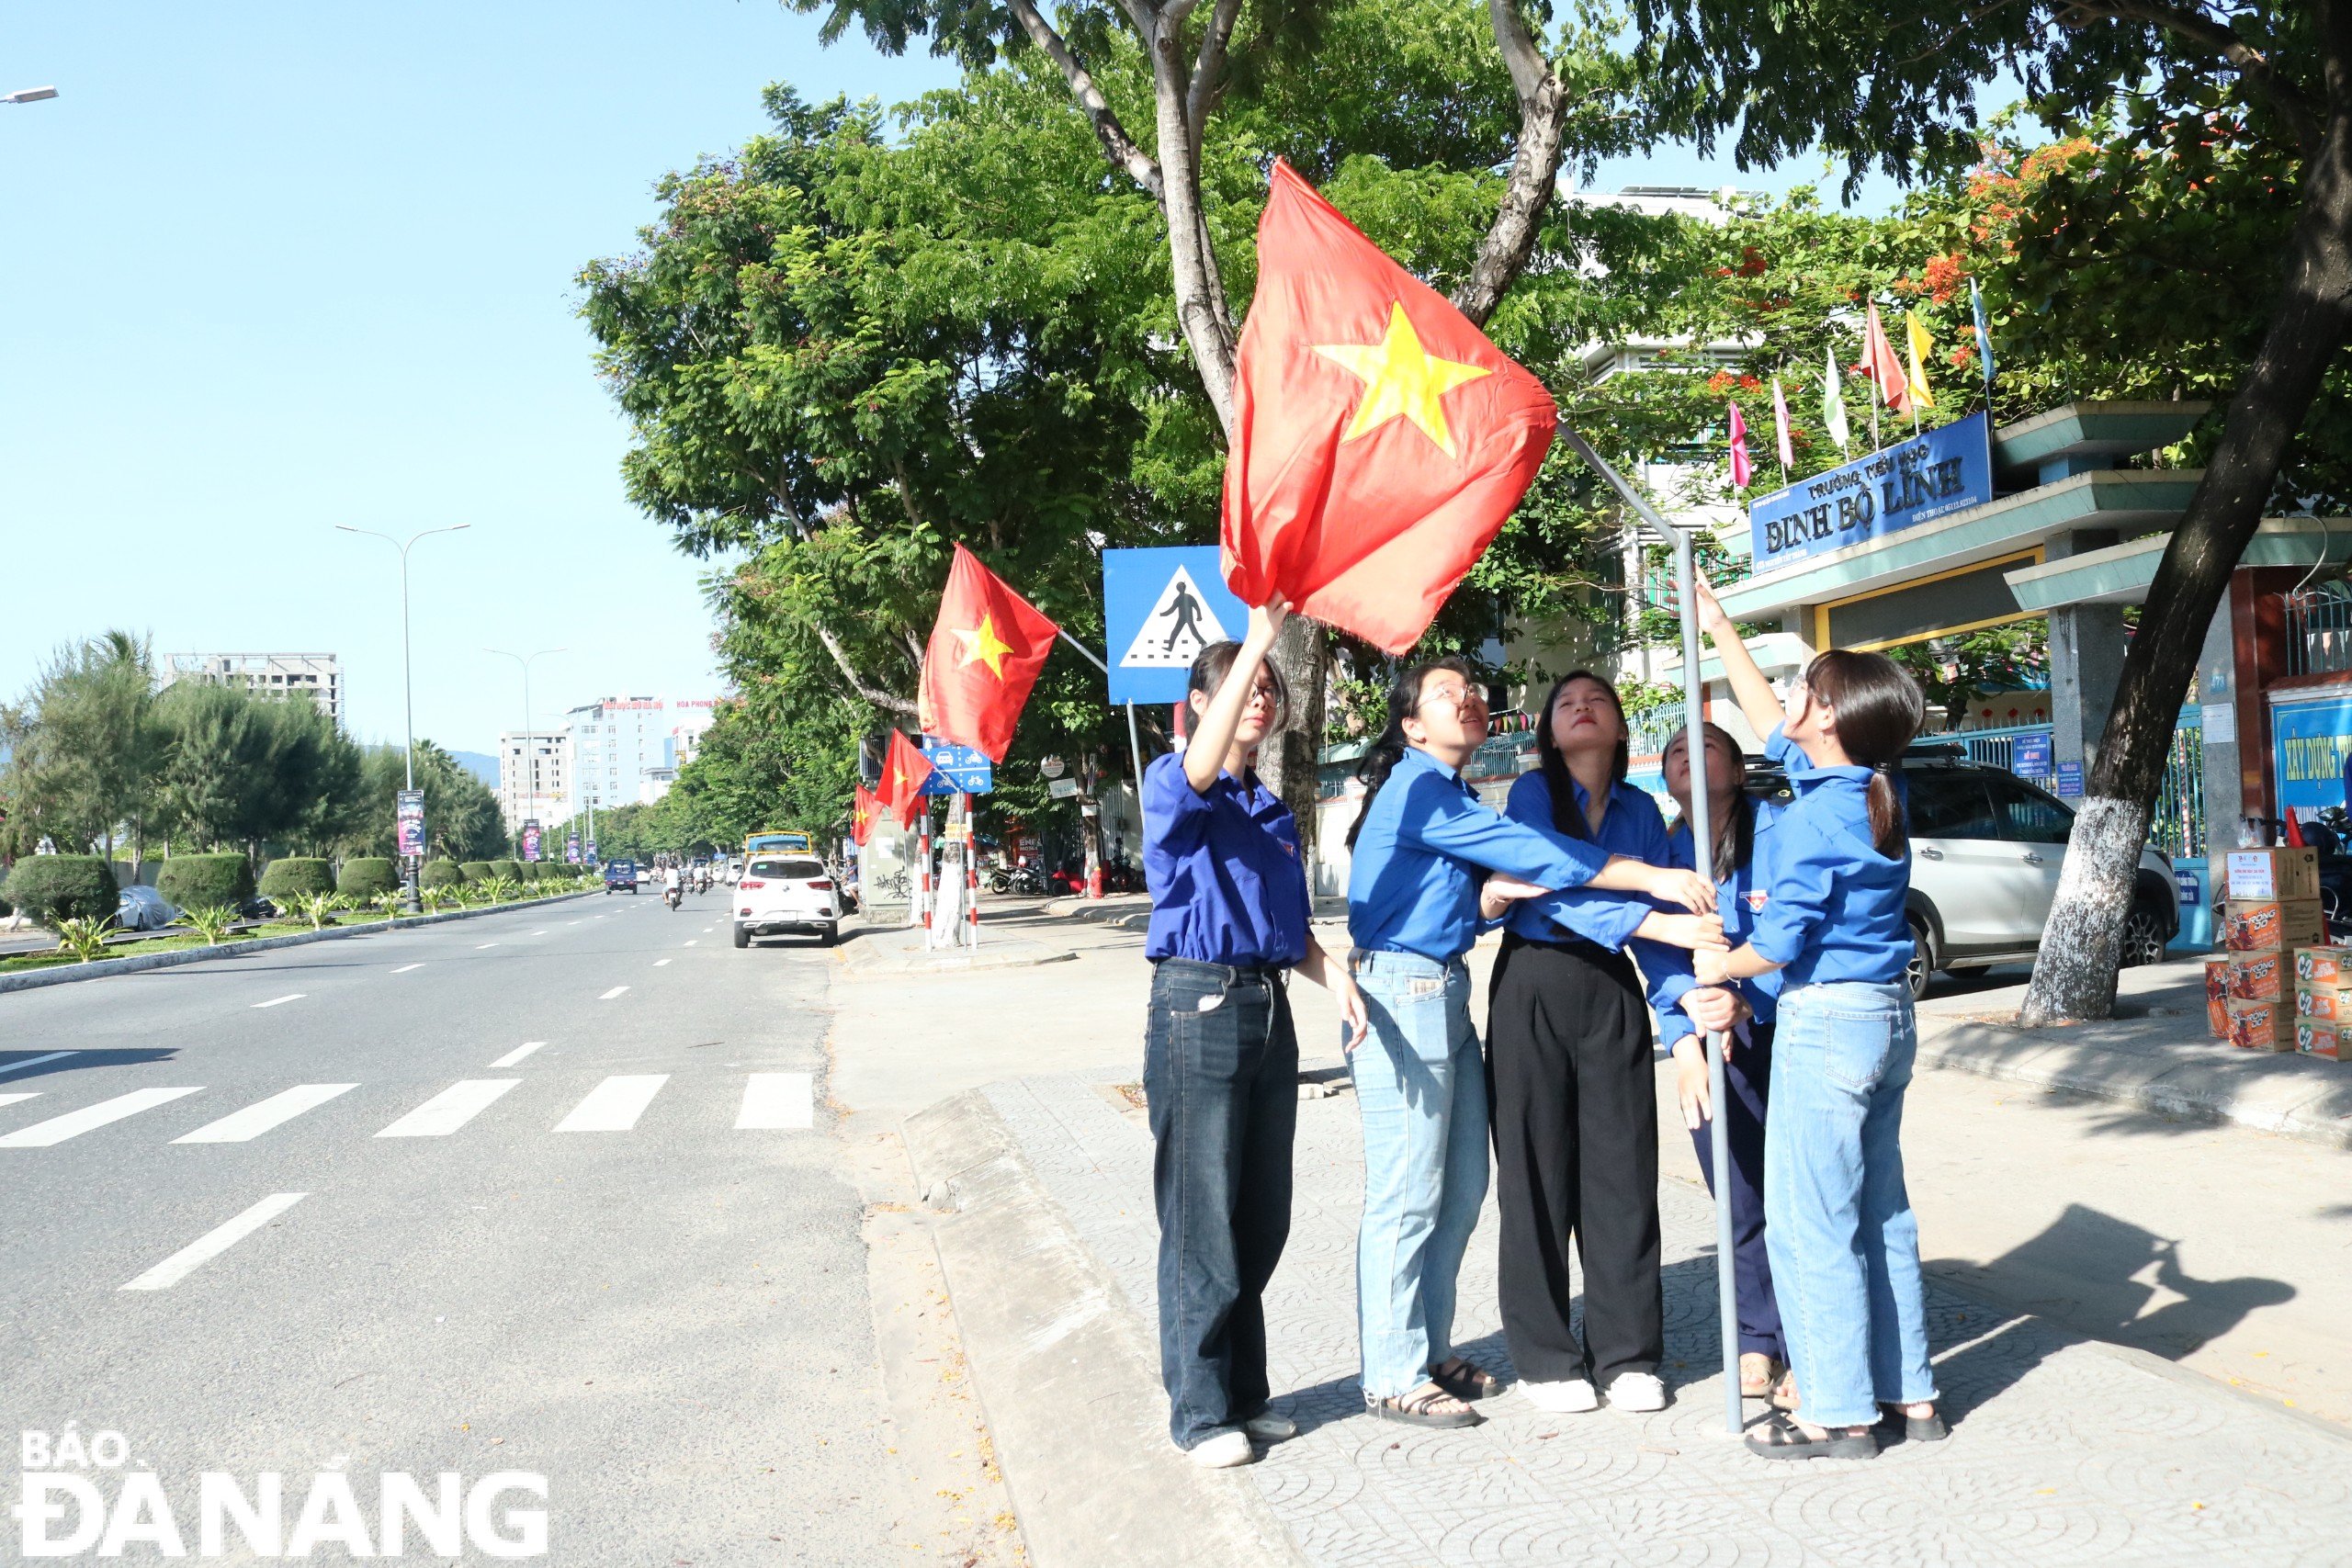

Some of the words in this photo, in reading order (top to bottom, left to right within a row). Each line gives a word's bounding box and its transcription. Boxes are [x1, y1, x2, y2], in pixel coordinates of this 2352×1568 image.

[1765, 502, 1834, 554] ĐINH
[1836, 482, 1877, 530] BỘ
[2284, 727, 2305, 781] XÂY
[2306, 732, 2336, 790] DỰNG
[2298, 954, 2312, 980] C2
[2299, 990, 2312, 1016] C2
[2339, 992, 2350, 1004] C2
[2299, 1026, 2312, 1051] C2
